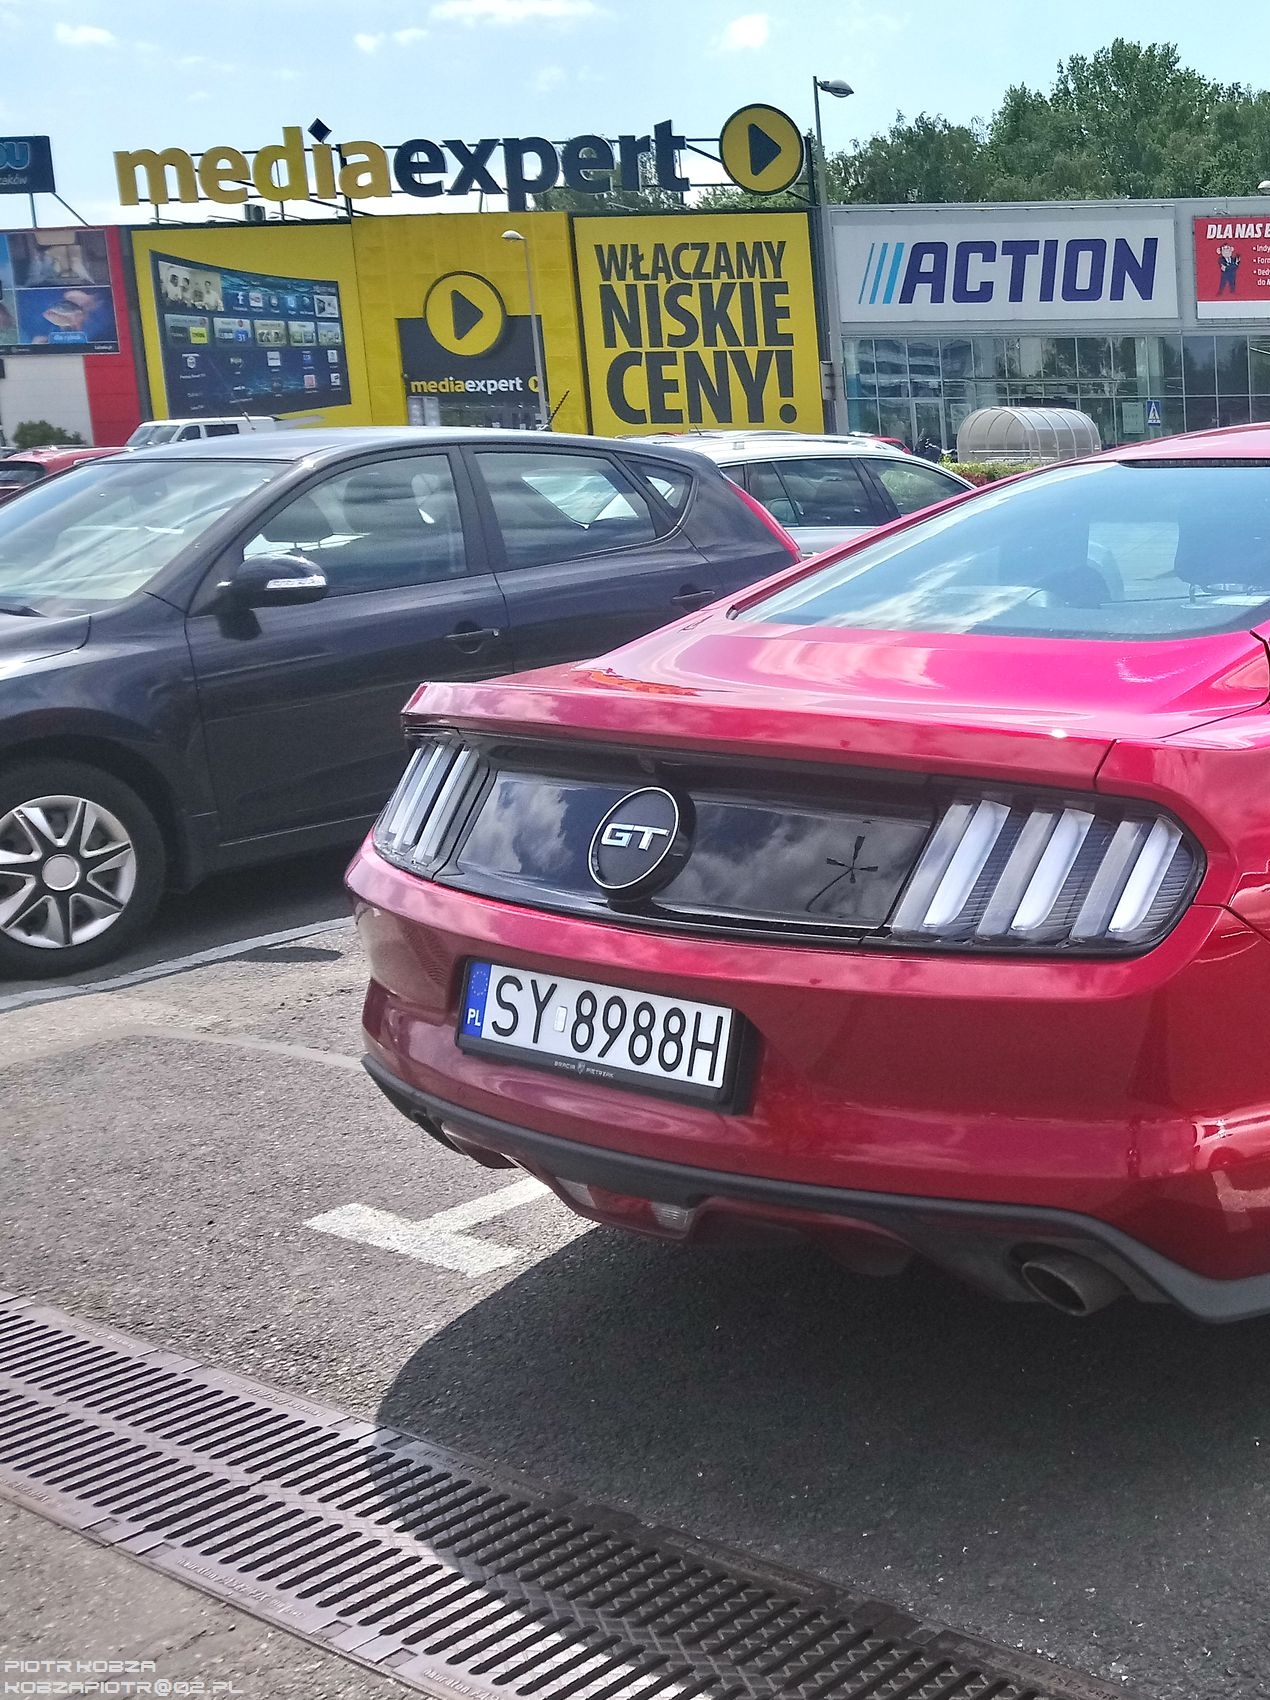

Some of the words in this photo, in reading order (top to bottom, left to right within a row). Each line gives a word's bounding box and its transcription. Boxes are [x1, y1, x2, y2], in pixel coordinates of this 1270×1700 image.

[113, 118, 690, 212] mediaexpert
[1207, 223, 1233, 239] DLA
[1234, 222, 1262, 238] NAS
[594, 241, 786, 284] WŁĄCZAMY
[899, 237, 1159, 304] ACTION
[1257, 278, 1266, 286] do
[599, 281, 794, 349] NISKIE
[410, 376, 523, 395] mediaexpert
[606, 350, 797, 424] CENY!
[601, 823, 670, 850] GT
[466, 1008, 481, 1027] PL
[491, 975, 558, 1044] SY
[570, 990, 724, 1081] 8988H
